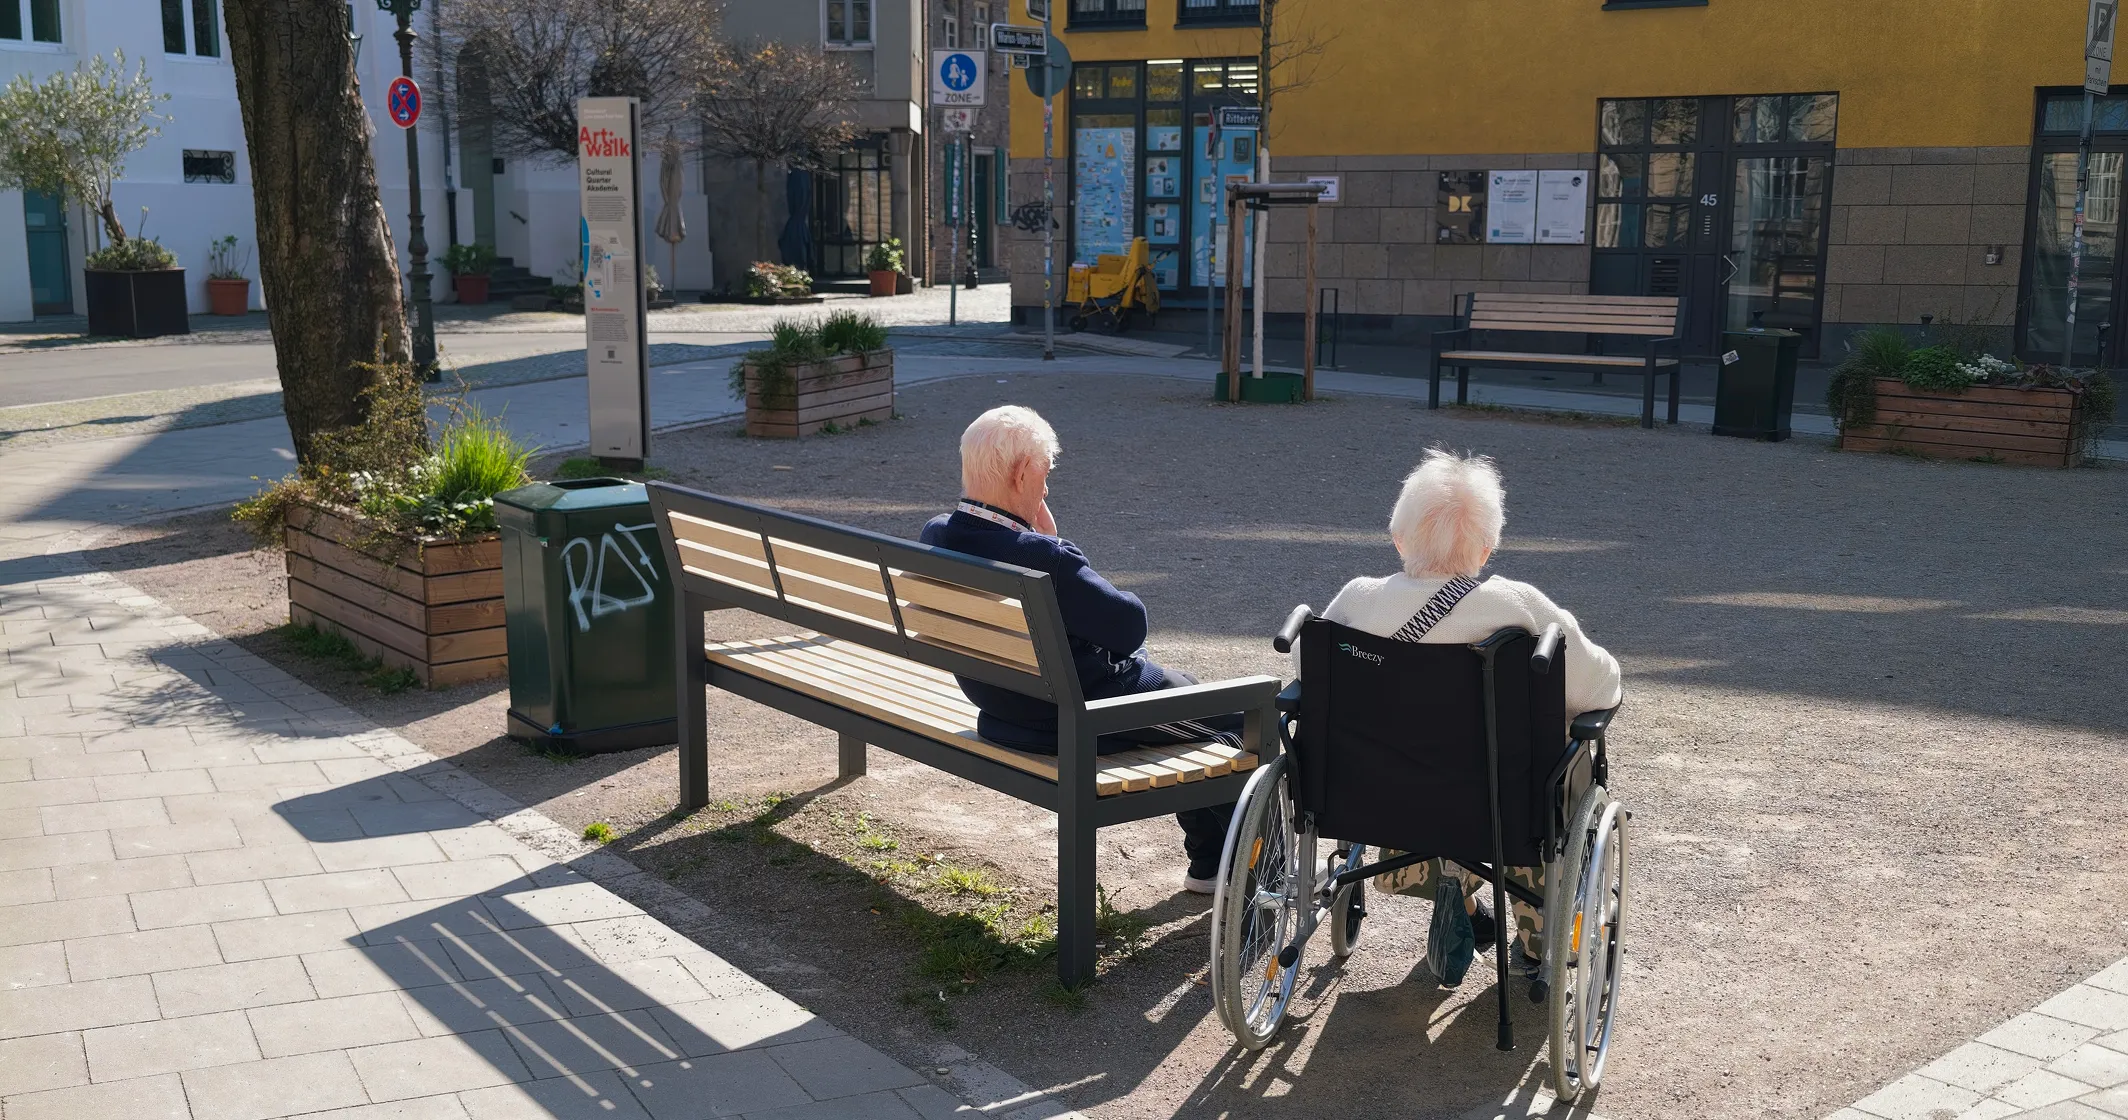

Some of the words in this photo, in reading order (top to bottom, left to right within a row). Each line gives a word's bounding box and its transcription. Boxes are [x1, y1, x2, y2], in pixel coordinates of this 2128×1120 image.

[2087, 75, 2107, 87] Parkschein
[945, 93, 973, 103] ZONE
[586, 168, 613, 176] Cultural
[586, 176, 612, 185] Quarter
[586, 184, 619, 192] Akademie
[1700, 194, 1717, 206] 45
